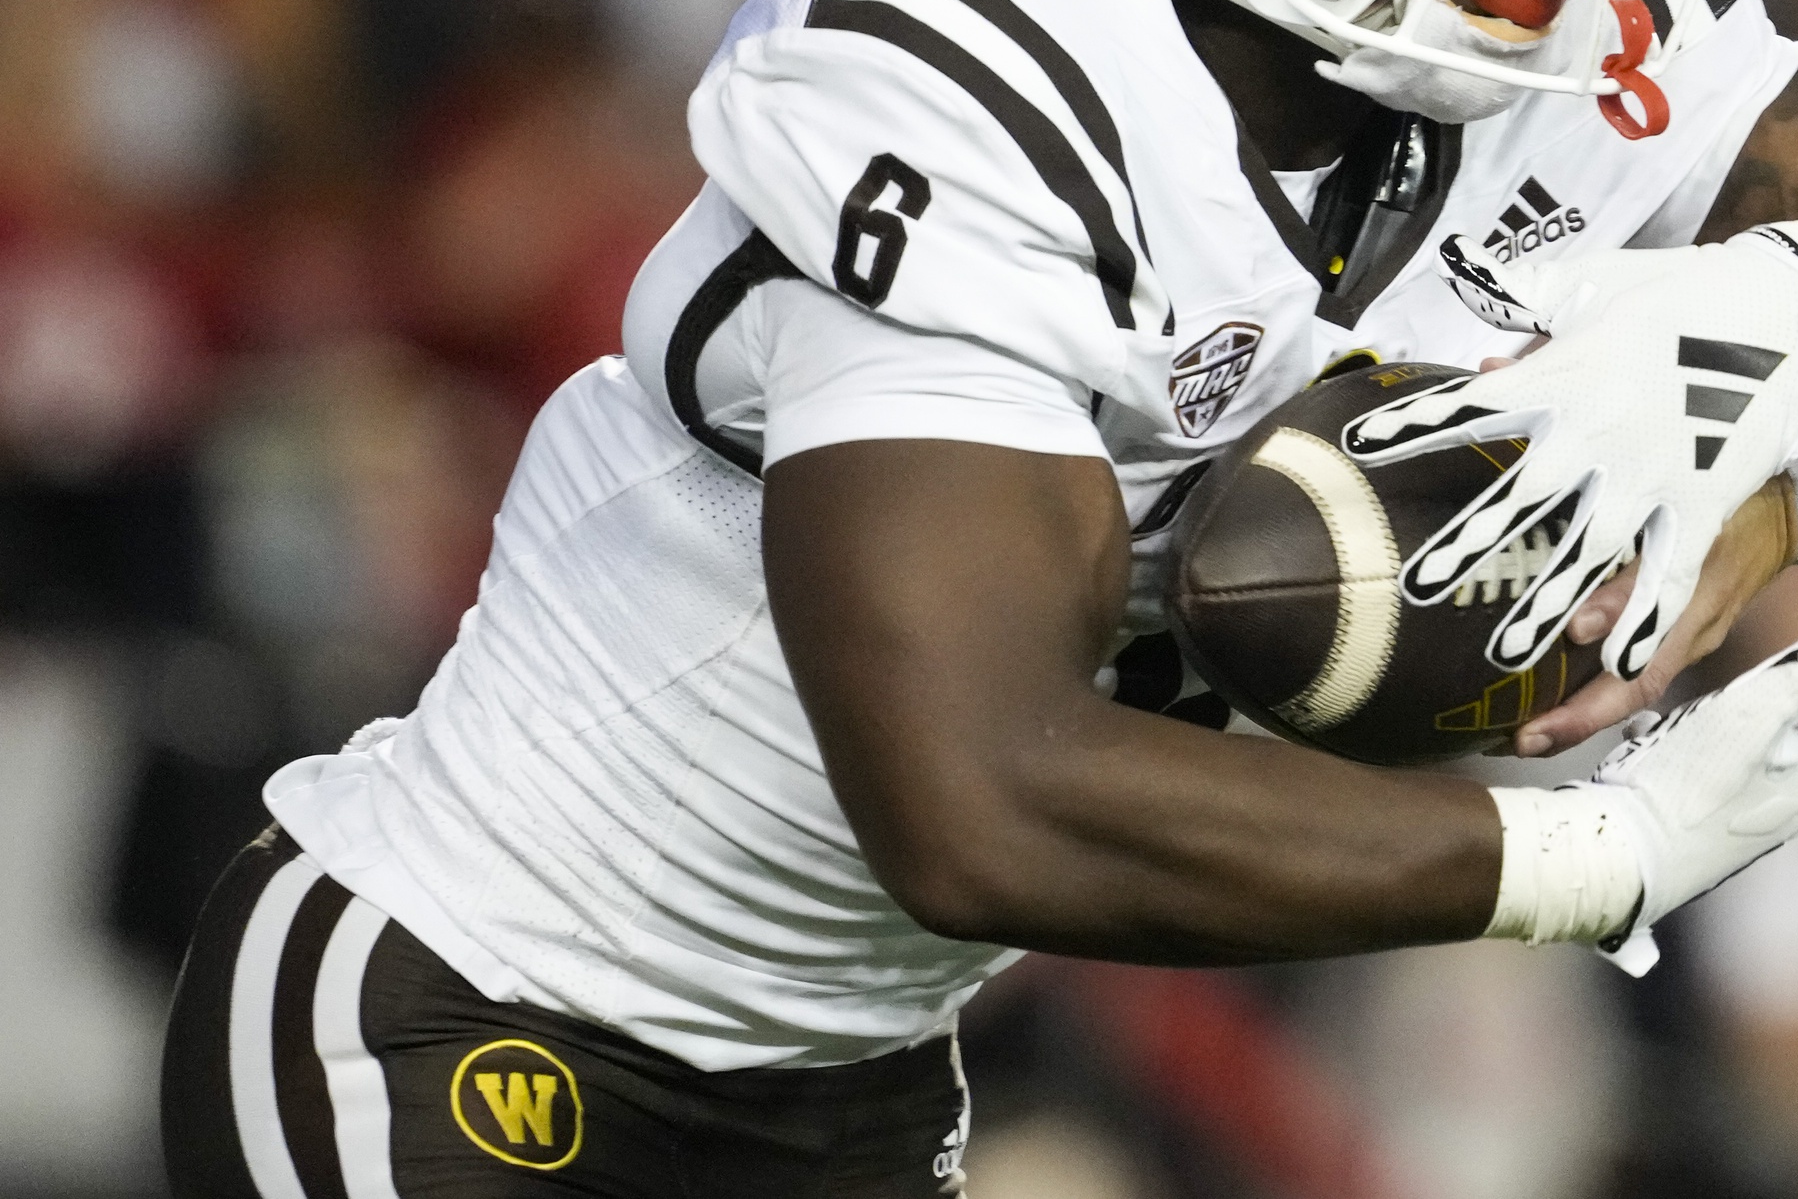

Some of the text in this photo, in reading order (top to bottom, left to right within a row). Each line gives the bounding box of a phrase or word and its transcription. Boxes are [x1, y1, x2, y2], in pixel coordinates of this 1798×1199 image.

[831, 152, 932, 311] 6
[1494, 206, 1586, 265] didas
[1172, 352, 1255, 407] MAC
[474, 1071, 558, 1147] W
